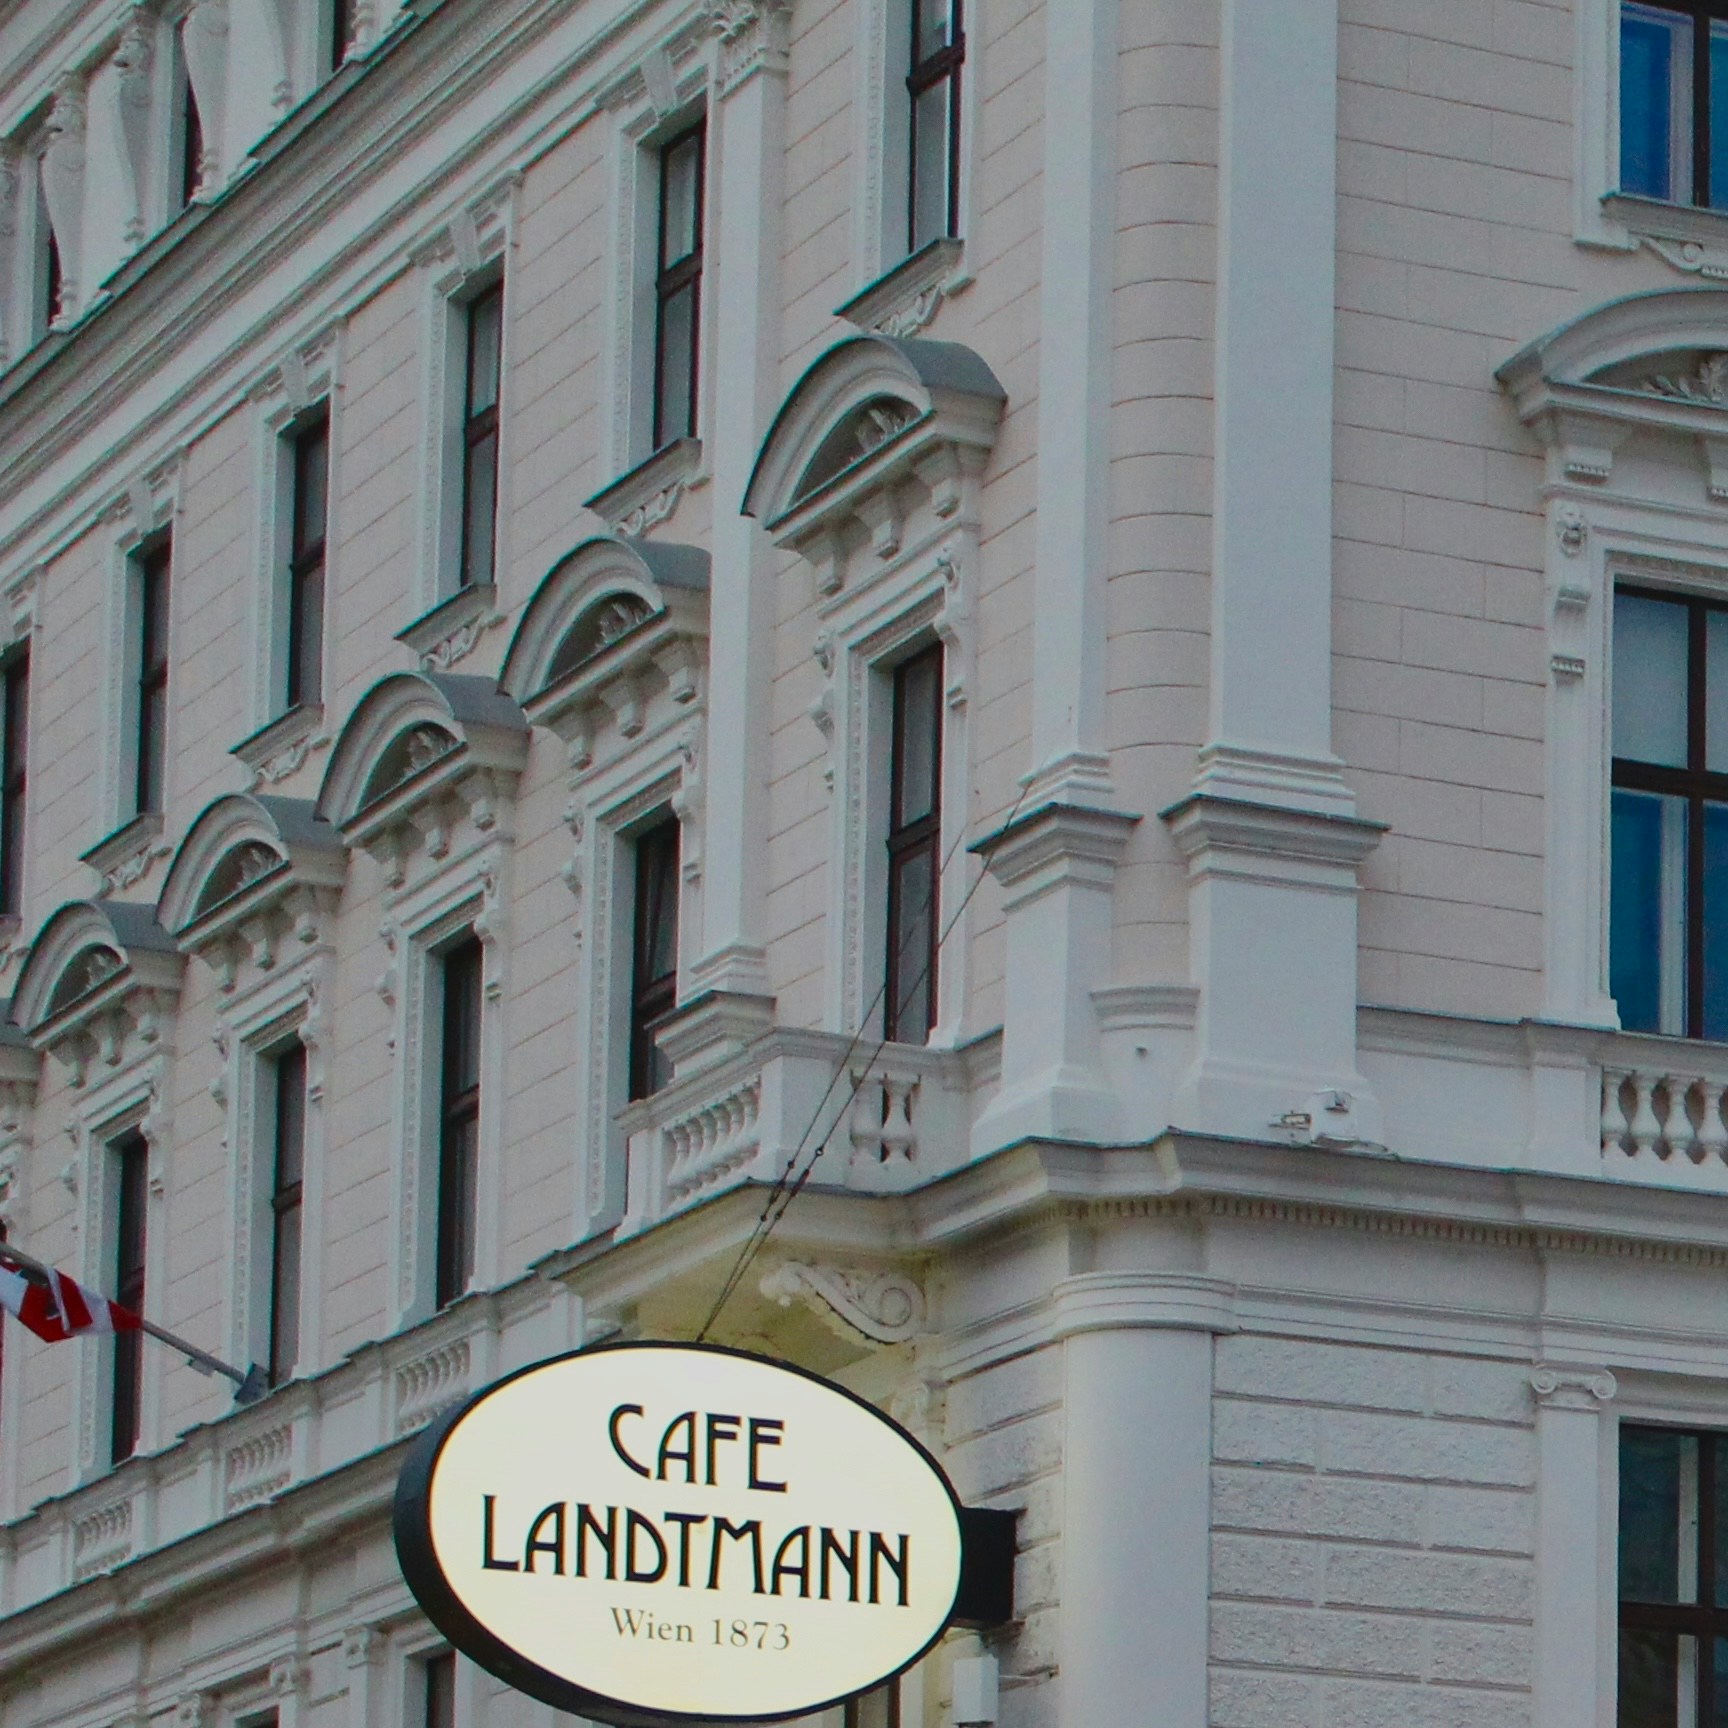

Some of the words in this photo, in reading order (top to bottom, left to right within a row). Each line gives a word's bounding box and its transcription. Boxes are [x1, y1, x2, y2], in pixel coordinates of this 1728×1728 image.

[608, 1403, 788, 1494] CAFE
[481, 1493, 911, 1608] LANDTMANN
[610, 1606, 694, 1643] Wien
[712, 1618, 790, 1650] 1873
